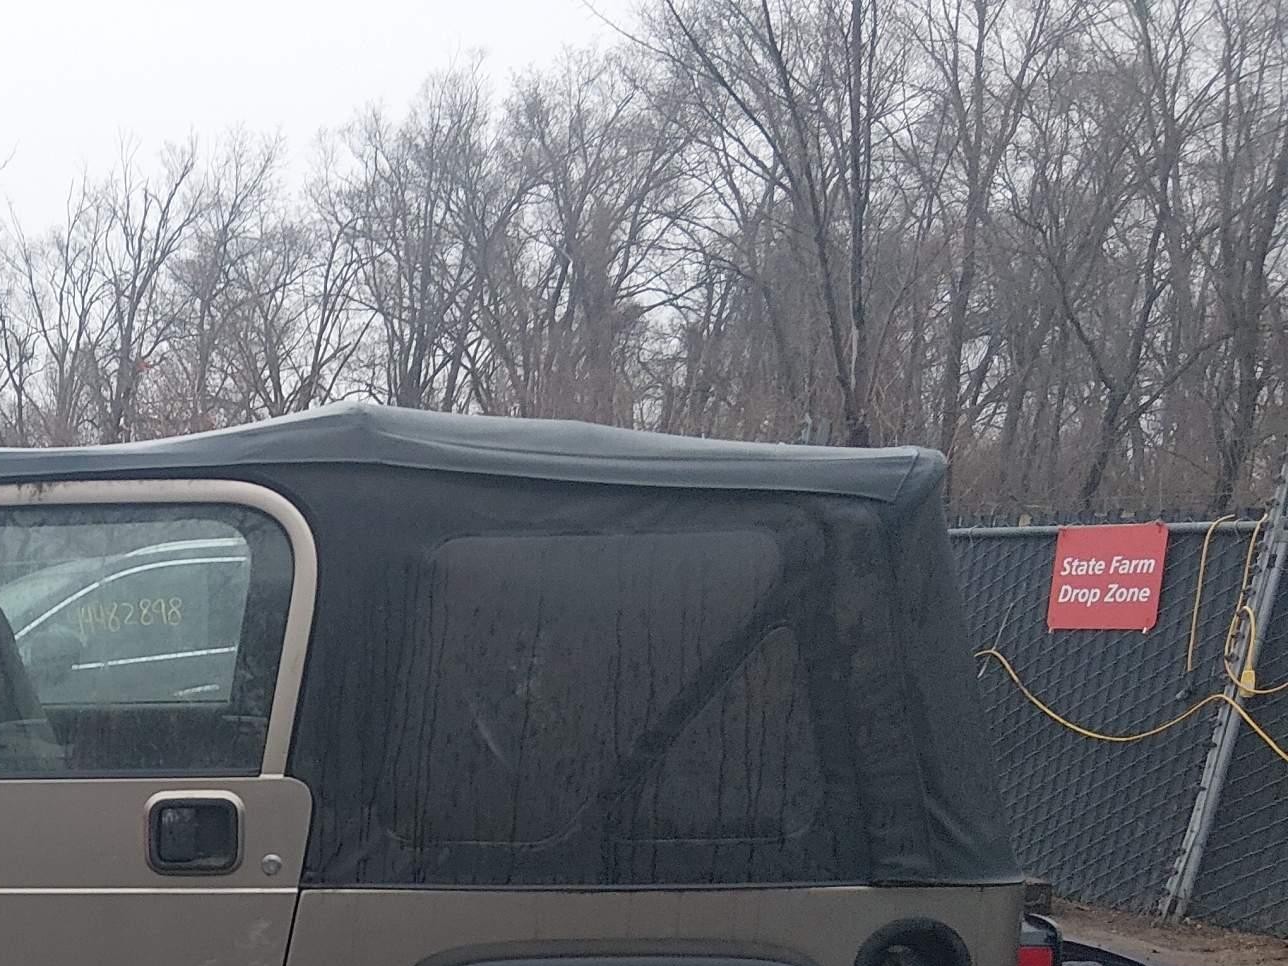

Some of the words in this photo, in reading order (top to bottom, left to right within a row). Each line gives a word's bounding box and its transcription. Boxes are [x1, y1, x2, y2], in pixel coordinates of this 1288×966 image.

[1059, 557, 1106, 576] State
[1109, 556, 1156, 574] Farm
[1058, 584, 1100, 607] Drop
[1104, 584, 1151, 602] Zone
